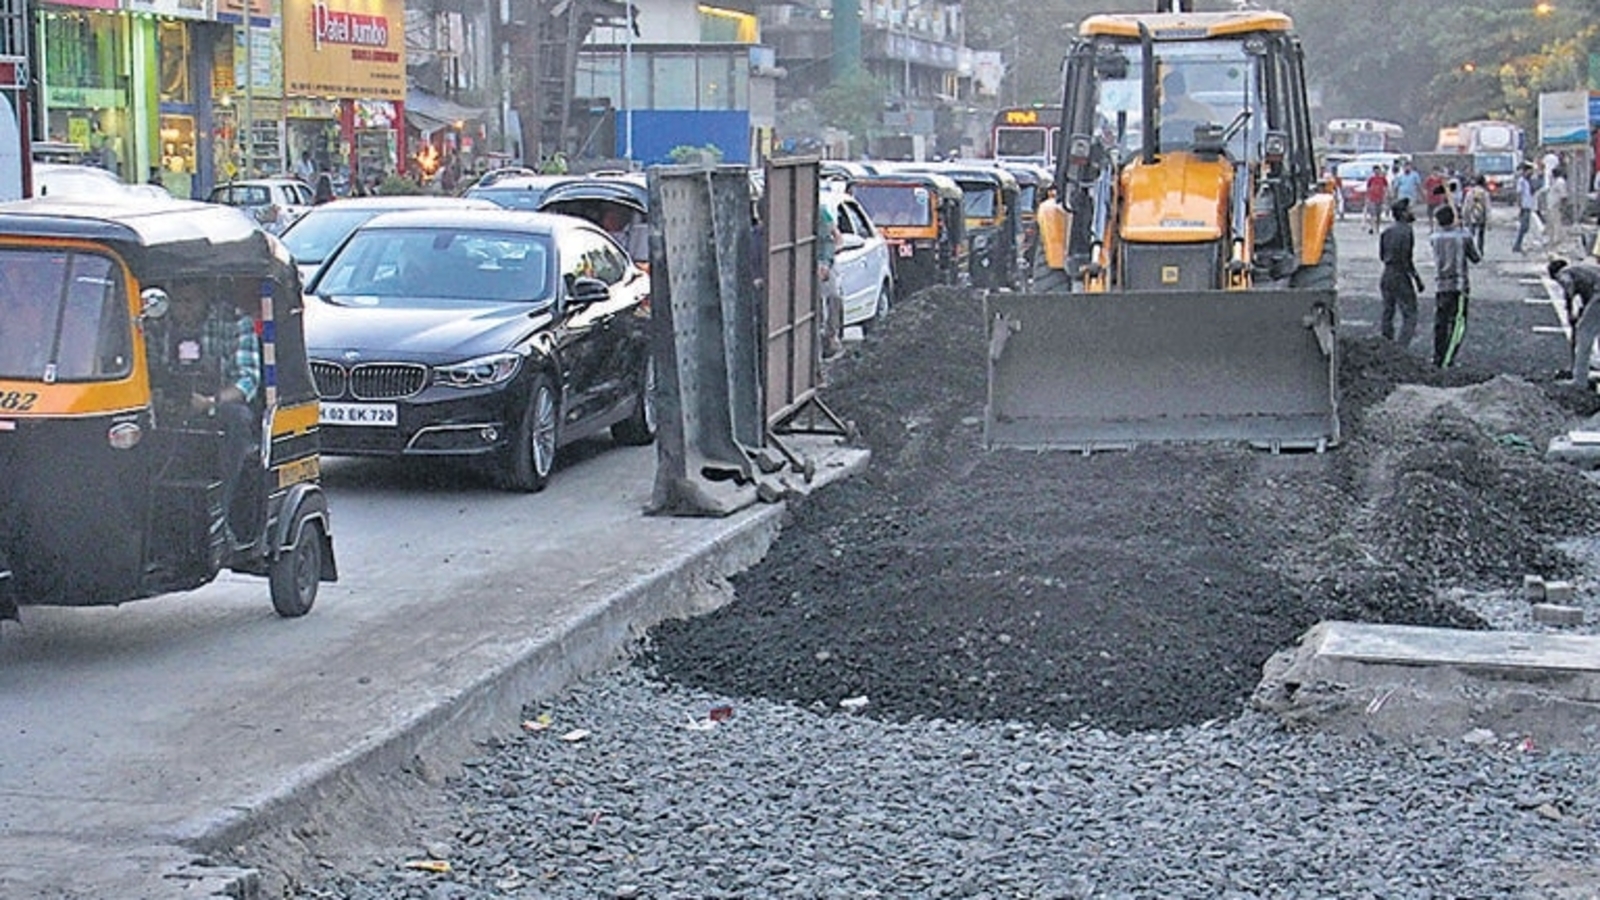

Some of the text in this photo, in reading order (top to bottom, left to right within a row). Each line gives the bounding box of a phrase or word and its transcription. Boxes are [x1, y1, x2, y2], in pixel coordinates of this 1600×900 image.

[315, 1, 386, 50] Patel Jumbo
[328, 408, 345, 420] 02
[369, 408, 395, 421] 720
